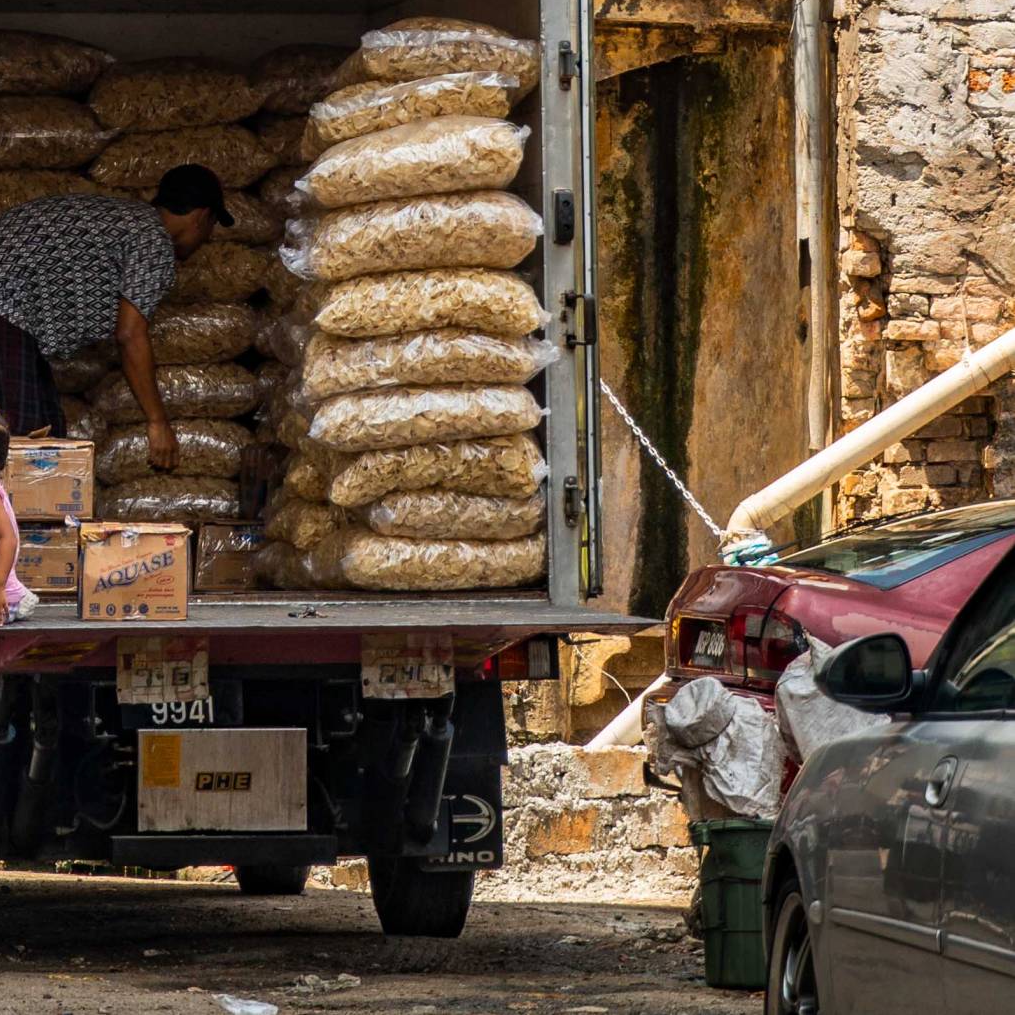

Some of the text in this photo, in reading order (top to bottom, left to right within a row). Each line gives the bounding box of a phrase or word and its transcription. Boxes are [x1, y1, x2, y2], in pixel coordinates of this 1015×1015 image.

[92, 550, 174, 594] AQUASE
[151, 695, 215, 725] 9941
[196, 773, 251, 791] PHE
